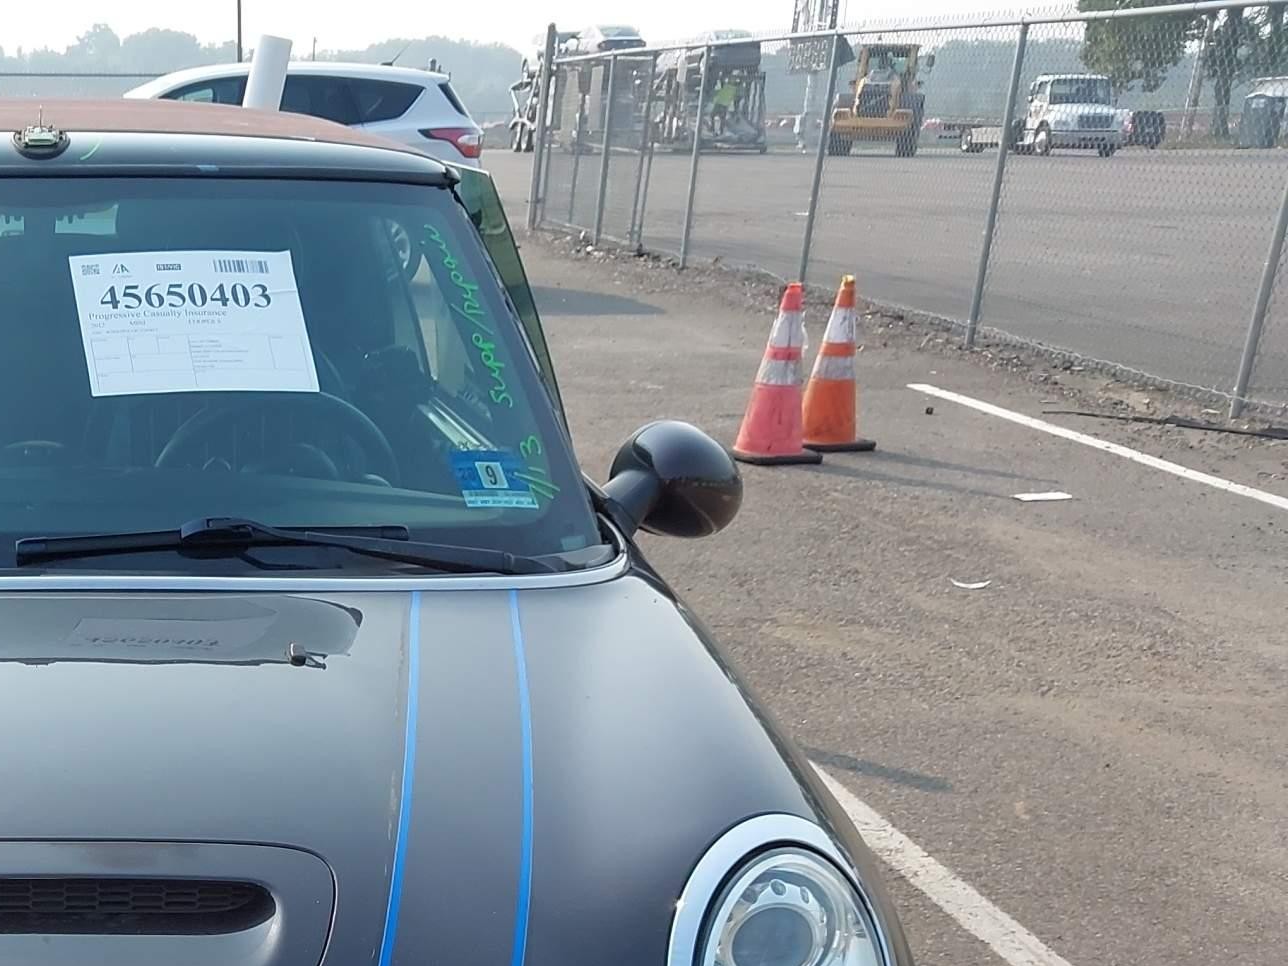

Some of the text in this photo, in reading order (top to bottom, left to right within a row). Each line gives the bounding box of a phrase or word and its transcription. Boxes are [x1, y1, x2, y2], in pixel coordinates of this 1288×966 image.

[100, 282, 272, 310] 45650403
[88, 309, 227, 320] Progressive Casualty Insurance
[485, 465, 498, 486] 9
